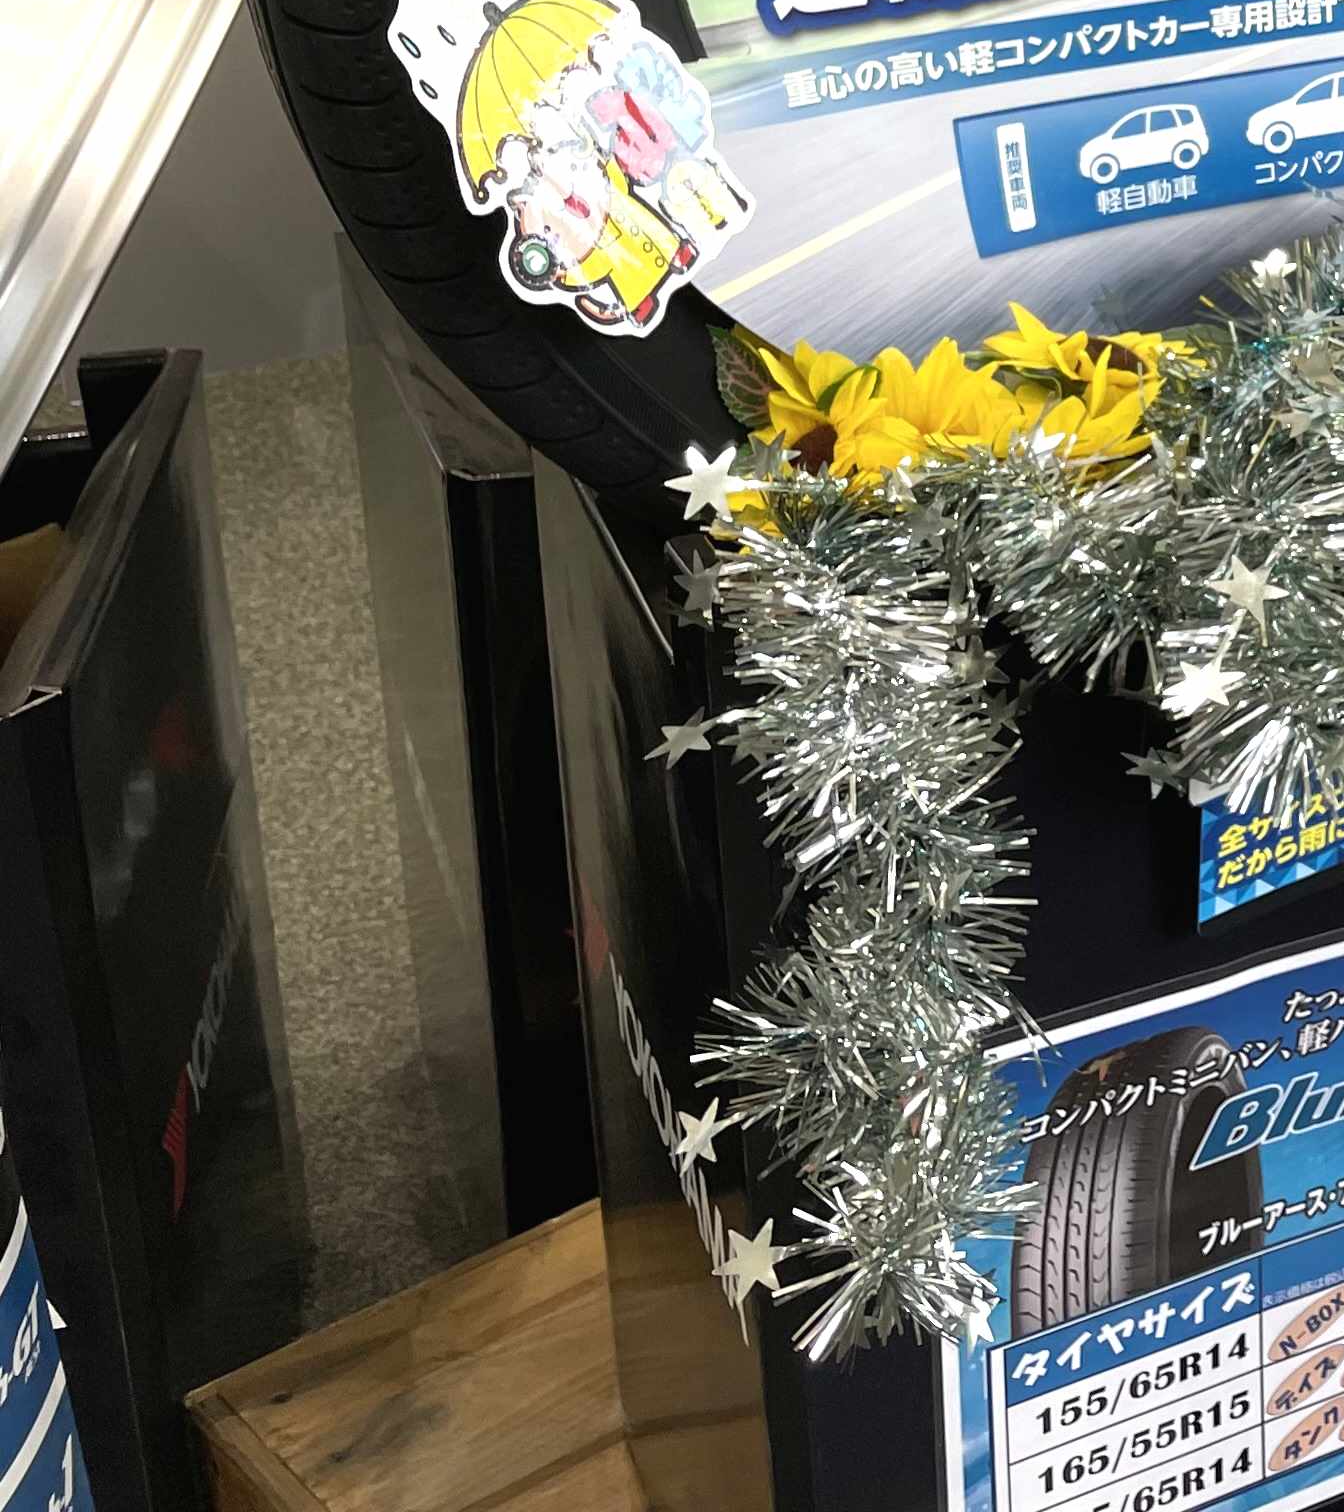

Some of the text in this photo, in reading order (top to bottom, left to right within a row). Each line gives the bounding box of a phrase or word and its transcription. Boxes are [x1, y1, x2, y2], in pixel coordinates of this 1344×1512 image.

[1097, 175, 1197, 214] 軽自動車
[1011, 1270, 1257, 1385] タイヤサイズ
[1036, 1333, 1249, 1435] 155/65R14
[1037, 1392, 1251, 1495] 165/55R15
[1091, 1447, 1253, 1512] /65R14
